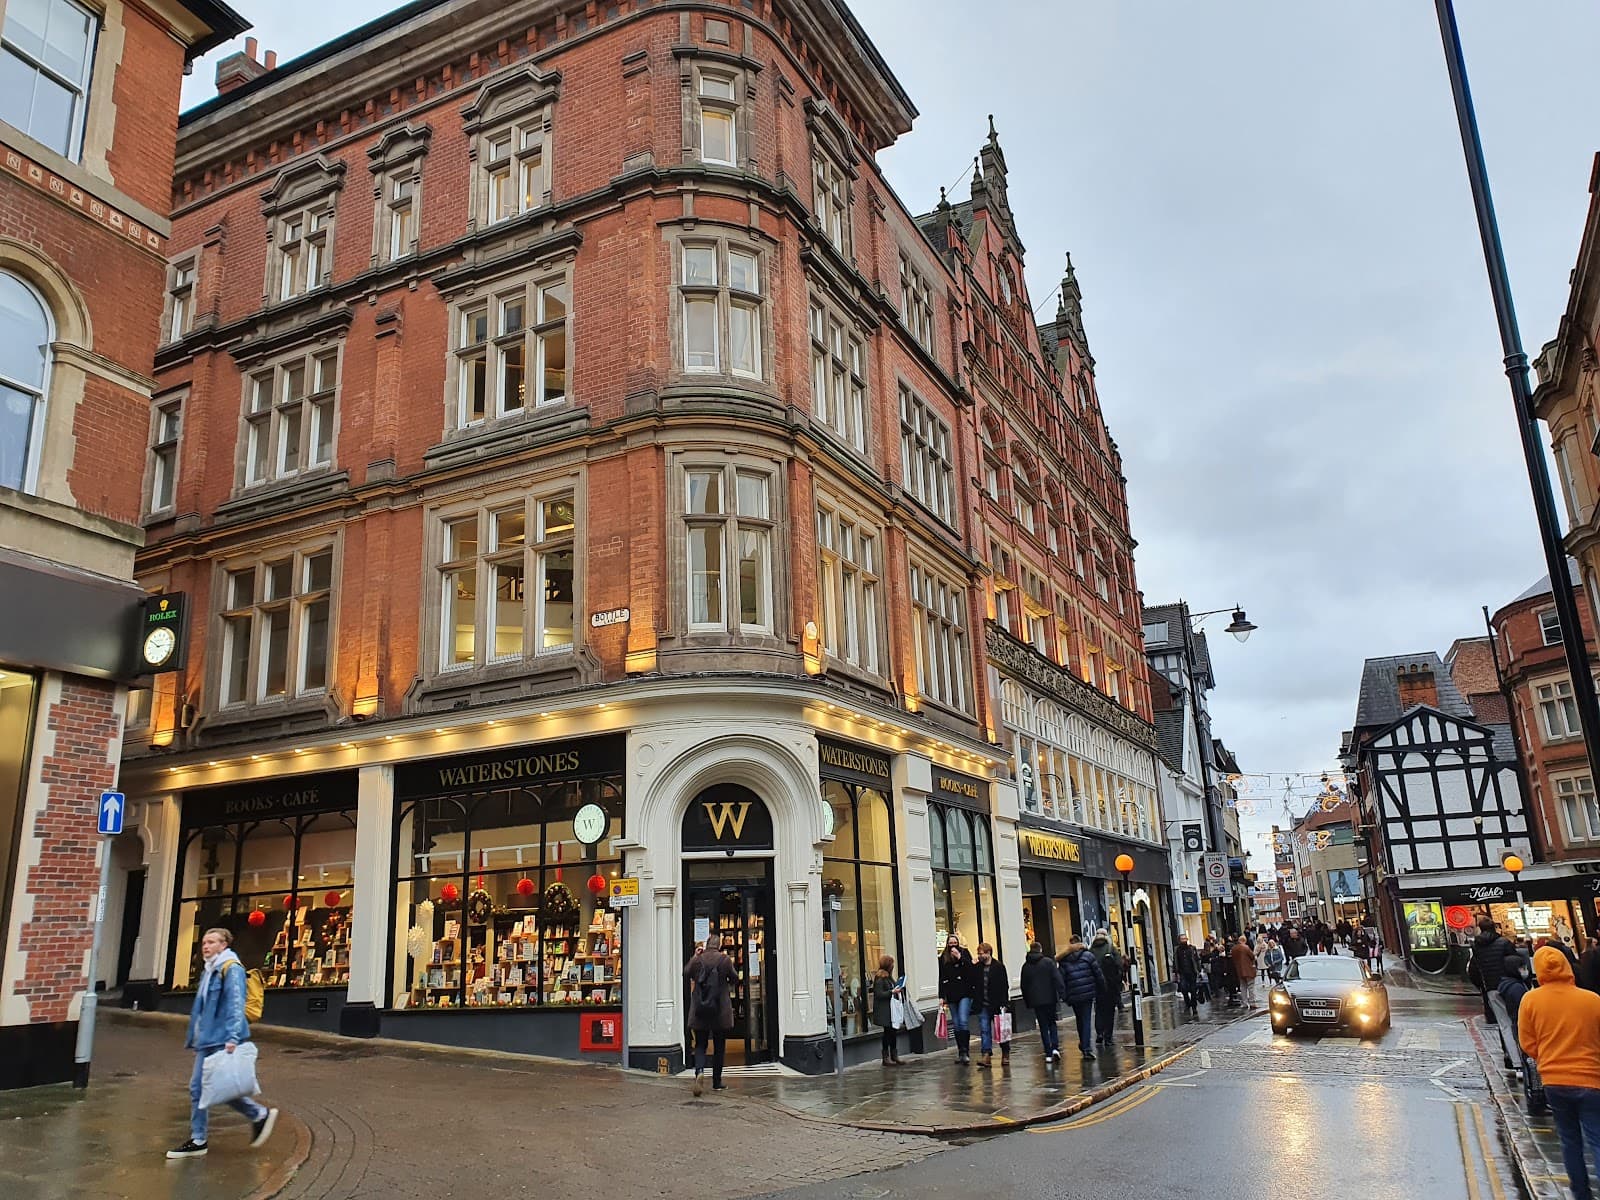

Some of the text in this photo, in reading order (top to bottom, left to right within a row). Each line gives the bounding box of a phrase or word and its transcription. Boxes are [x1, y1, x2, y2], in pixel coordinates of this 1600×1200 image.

[149, 610, 177, 621] ROLEX
[595, 609, 625, 621] BOTTLE
[439, 751, 580, 787] WATERSTONES
[820, 743, 889, 778] WATERSTONES
[940, 776, 961, 793] BOOKS
[225, 785, 320, 814] BOOKS CAFÉ
[582, 818, 596, 831] W
[701, 802, 752, 840] W
[1027, 835, 1080, 862] WATERSTONES
[1469, 886, 1504, 900] Kiehl's
